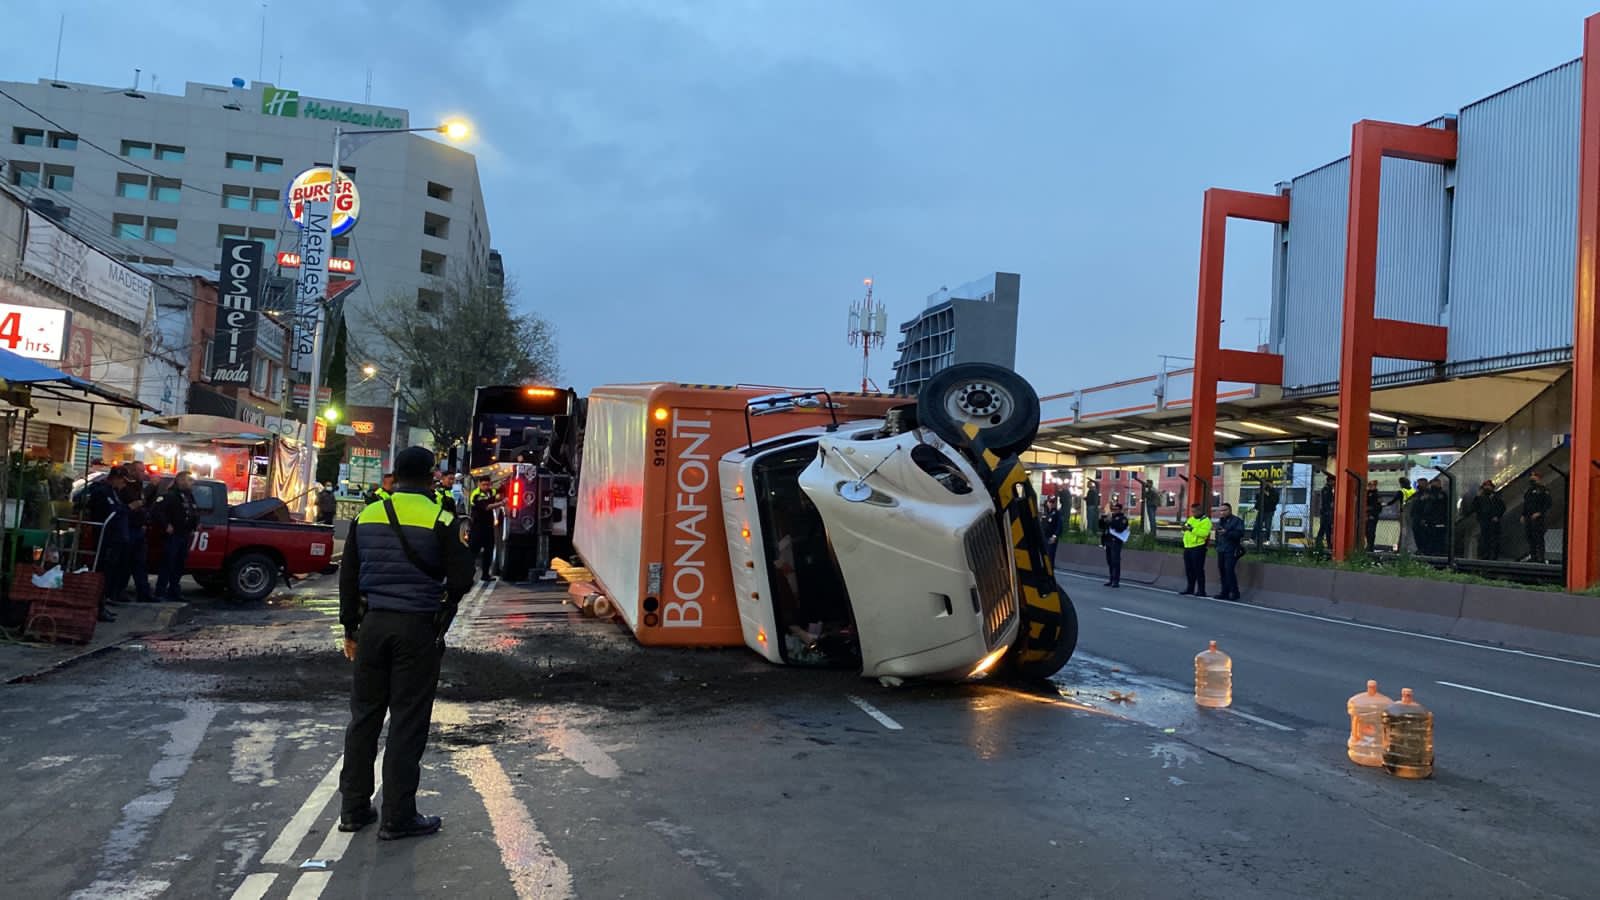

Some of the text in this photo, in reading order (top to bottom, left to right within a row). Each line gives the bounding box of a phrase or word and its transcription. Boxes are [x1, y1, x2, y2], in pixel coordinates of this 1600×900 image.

[304, 101, 403, 128] Holiday Inn
[305, 214, 328, 294] Metales
[25, 338, 54, 353] hrs.
[214, 363, 249, 382] moda
[653, 428, 666, 466] 9199
[663, 408, 712, 628] BONAFONT
